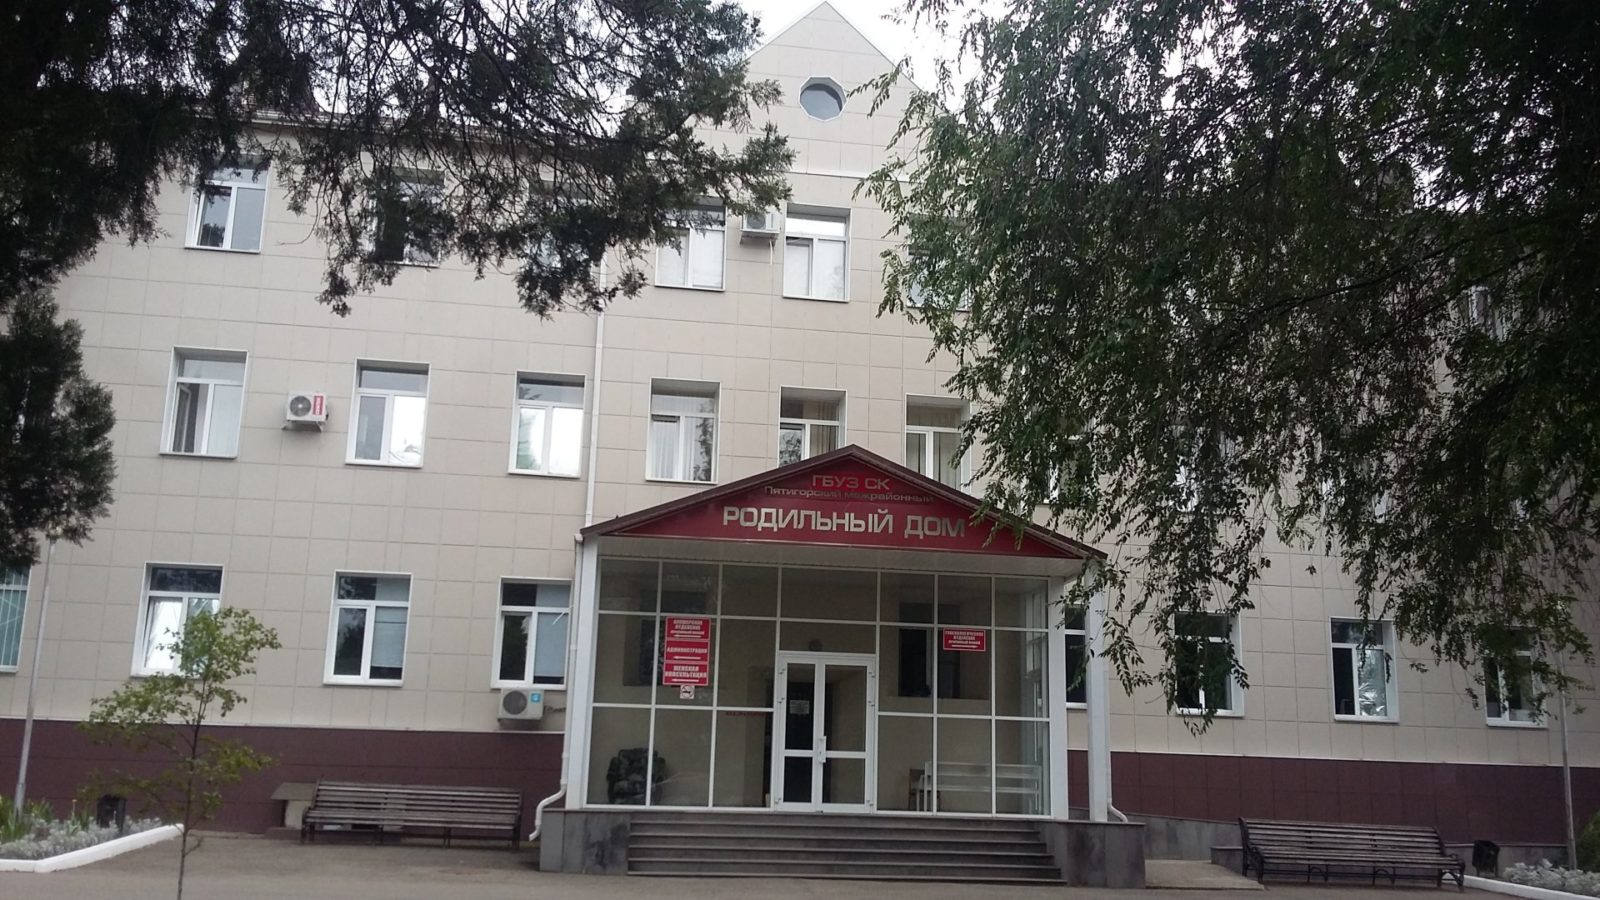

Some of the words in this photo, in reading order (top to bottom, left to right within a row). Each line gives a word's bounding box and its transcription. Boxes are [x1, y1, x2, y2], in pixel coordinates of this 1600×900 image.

[812, 475, 859, 489] ГБУЗ
[864, 478, 890, 490] СК
[765, 486, 841, 498] Пятигорский
[723, 506, 894, 534] РОДИЛЬНЫЙ
[904, 515, 965, 539] ДОМ
